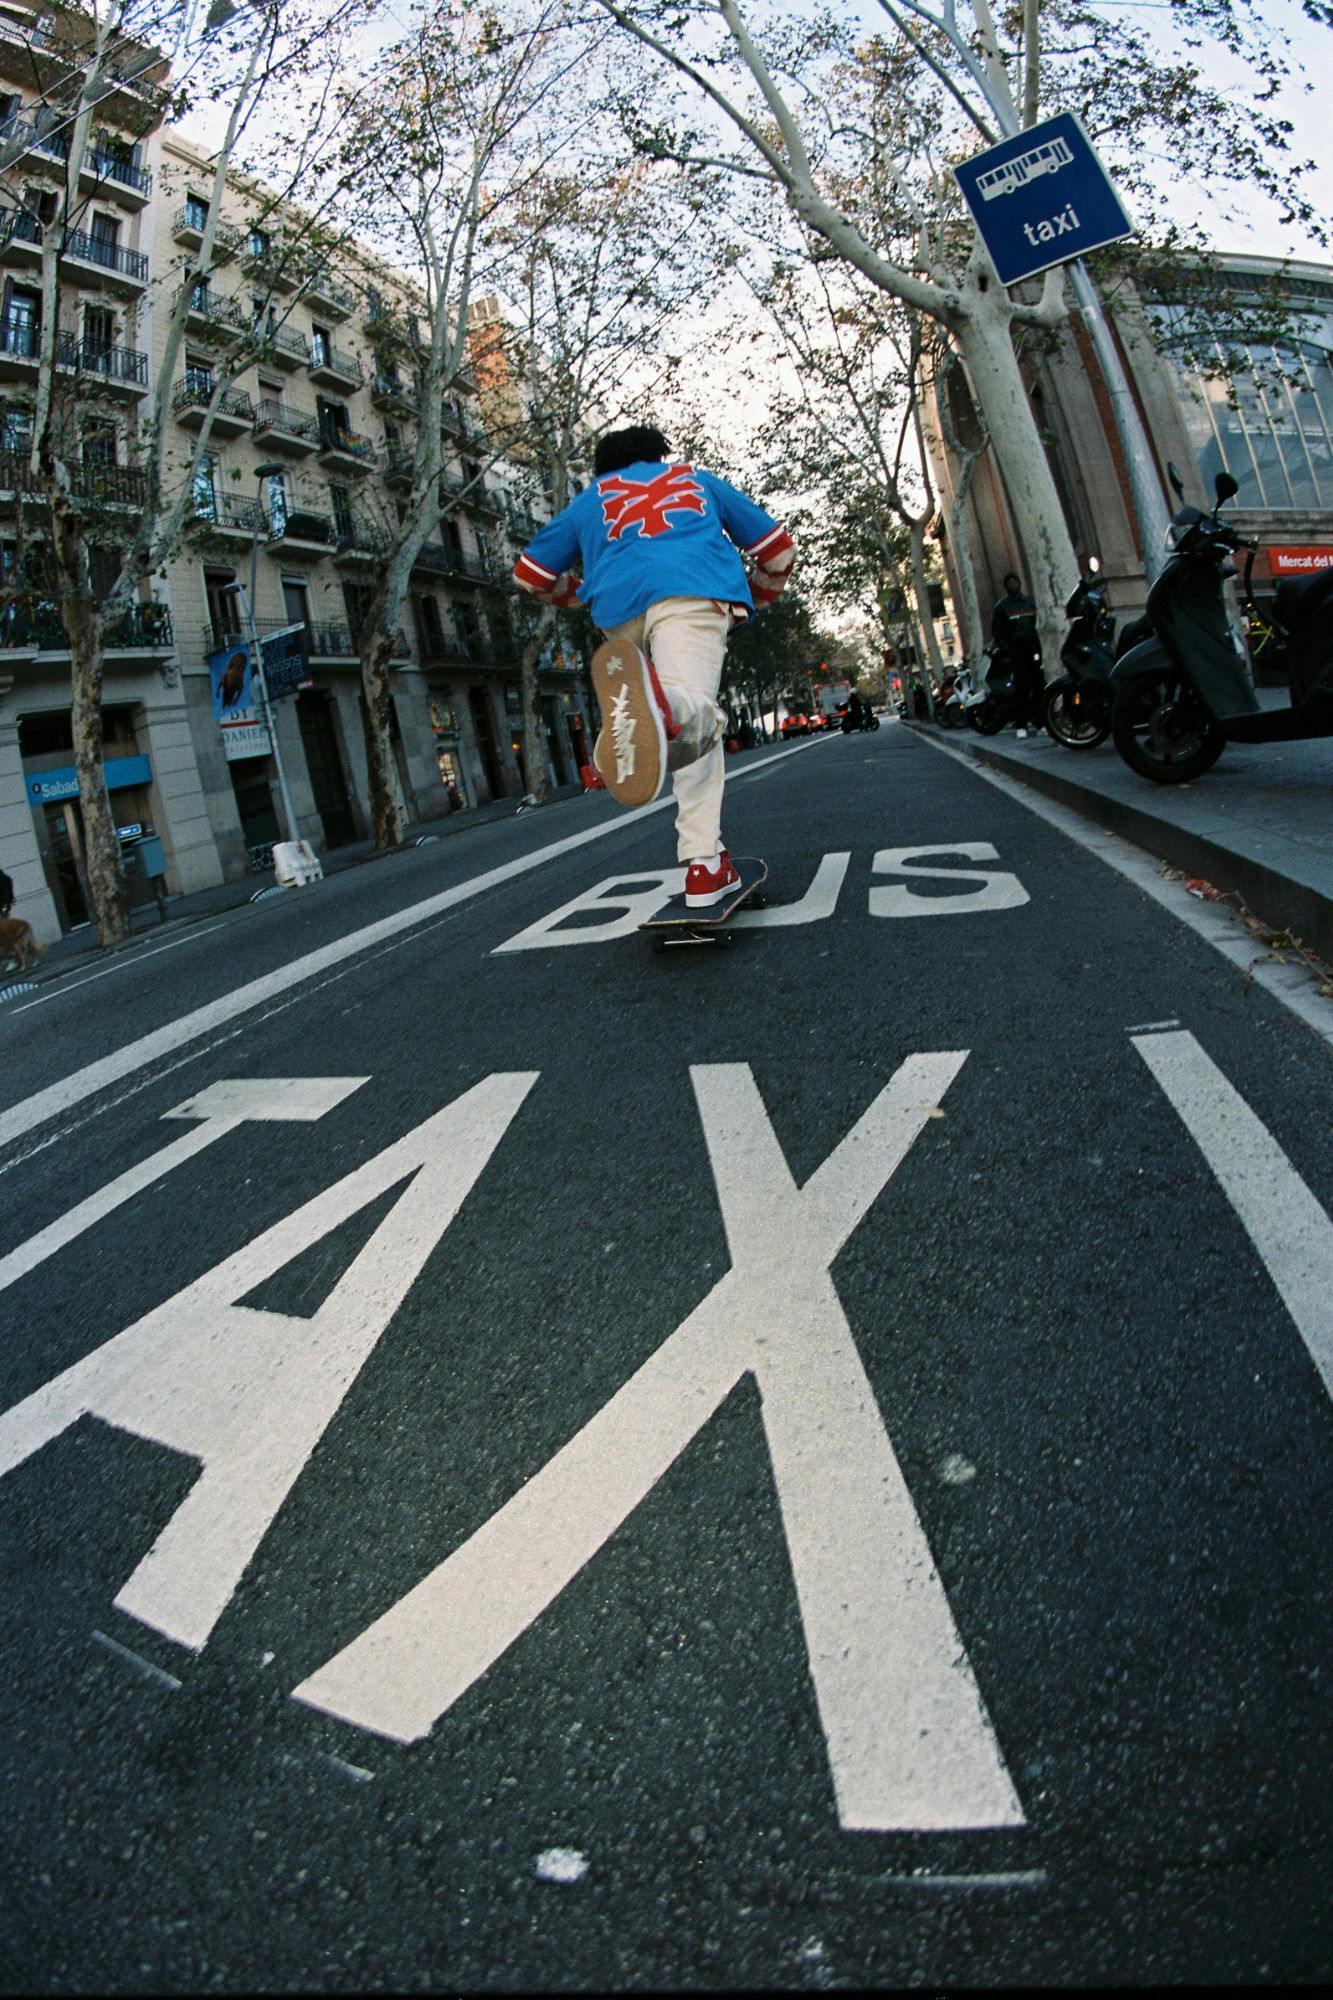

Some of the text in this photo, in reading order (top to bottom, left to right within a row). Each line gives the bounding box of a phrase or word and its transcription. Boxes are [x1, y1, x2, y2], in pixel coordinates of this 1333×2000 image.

[1023, 203, 1081, 247] taxi
[1278, 555, 1313, 567] Mercat
[41, 777, 79, 798] Sabad
[491, 841, 1031, 954] BUS
